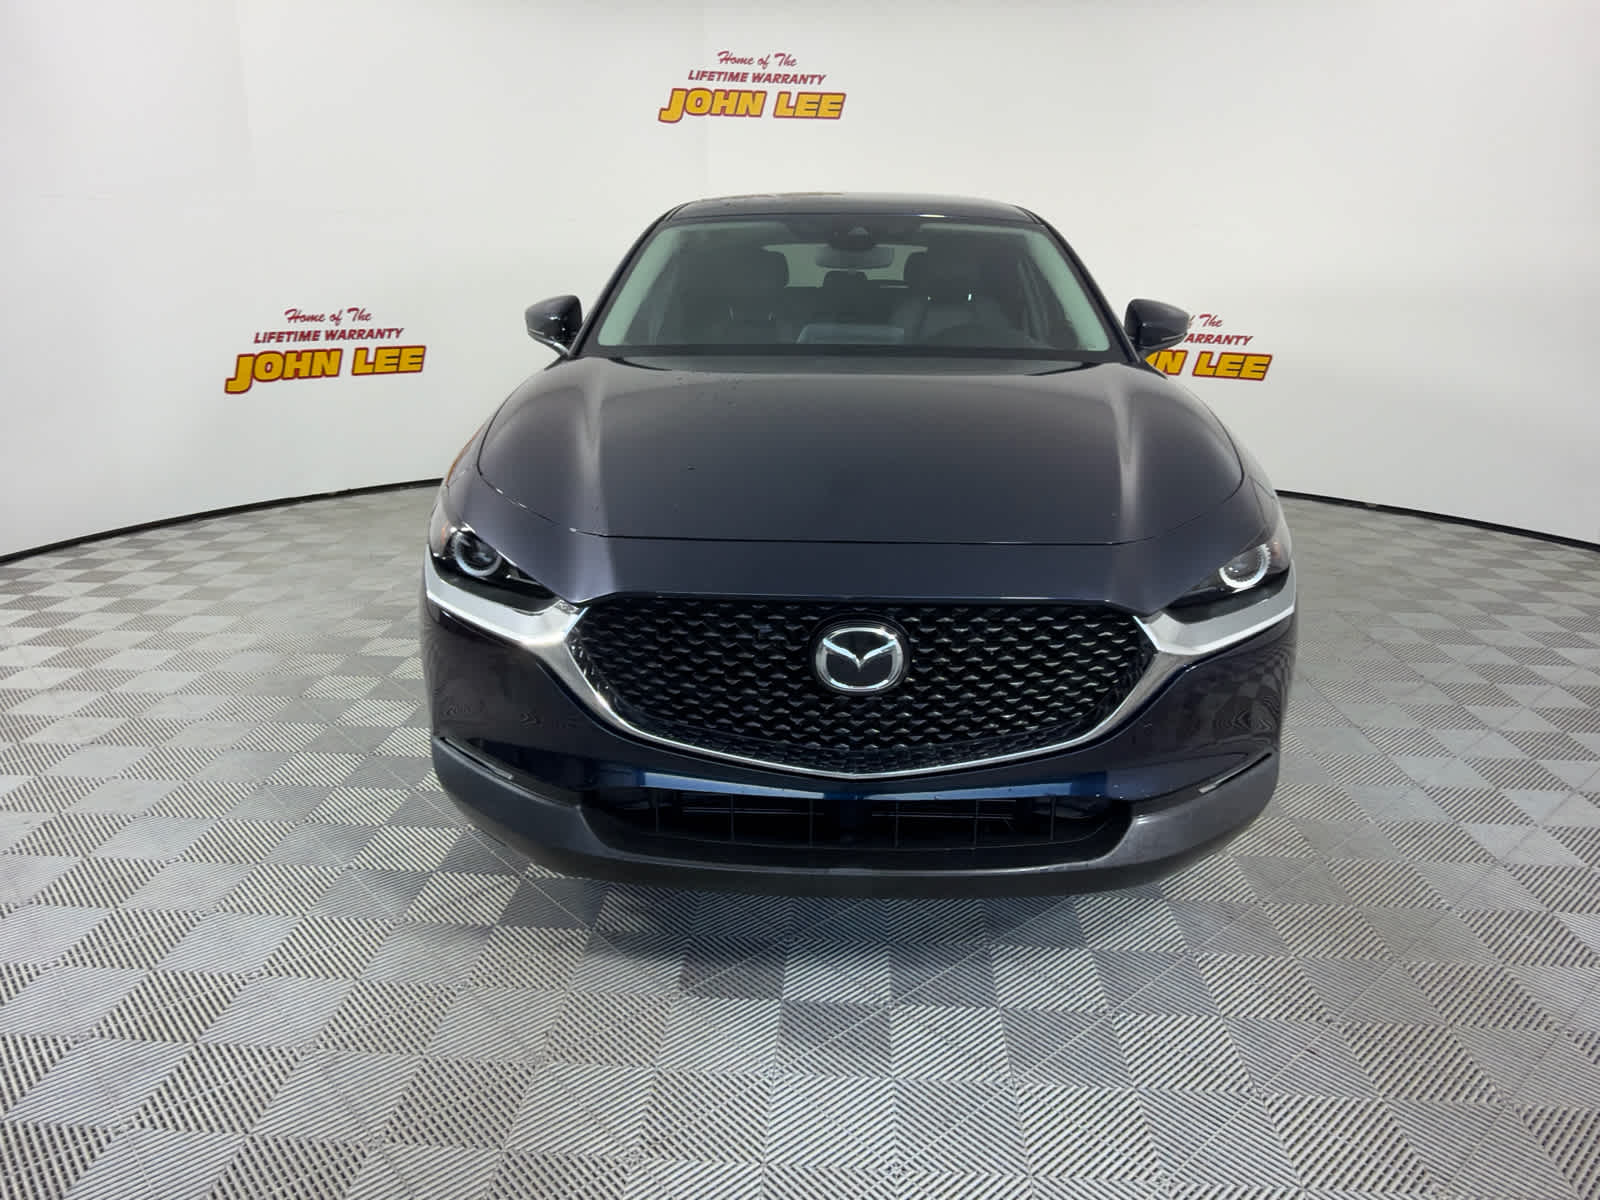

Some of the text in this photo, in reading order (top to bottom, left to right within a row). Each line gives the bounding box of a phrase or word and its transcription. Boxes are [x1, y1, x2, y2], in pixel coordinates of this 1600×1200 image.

[717, 51, 798, 69] Home of The
[688, 70, 826, 85] LIFETIME WARRANTY
[658, 88, 847, 124] JOHN LEE
[284, 307, 373, 326] Home of The
[1199, 313, 1224, 328] The
[254, 328, 405, 344] LIFETIME WARRANTY
[1183, 333, 1254, 346] ARRANTY
[224, 345, 427, 394] JOHN LEE
[1192, 351, 1273, 381] LEE
